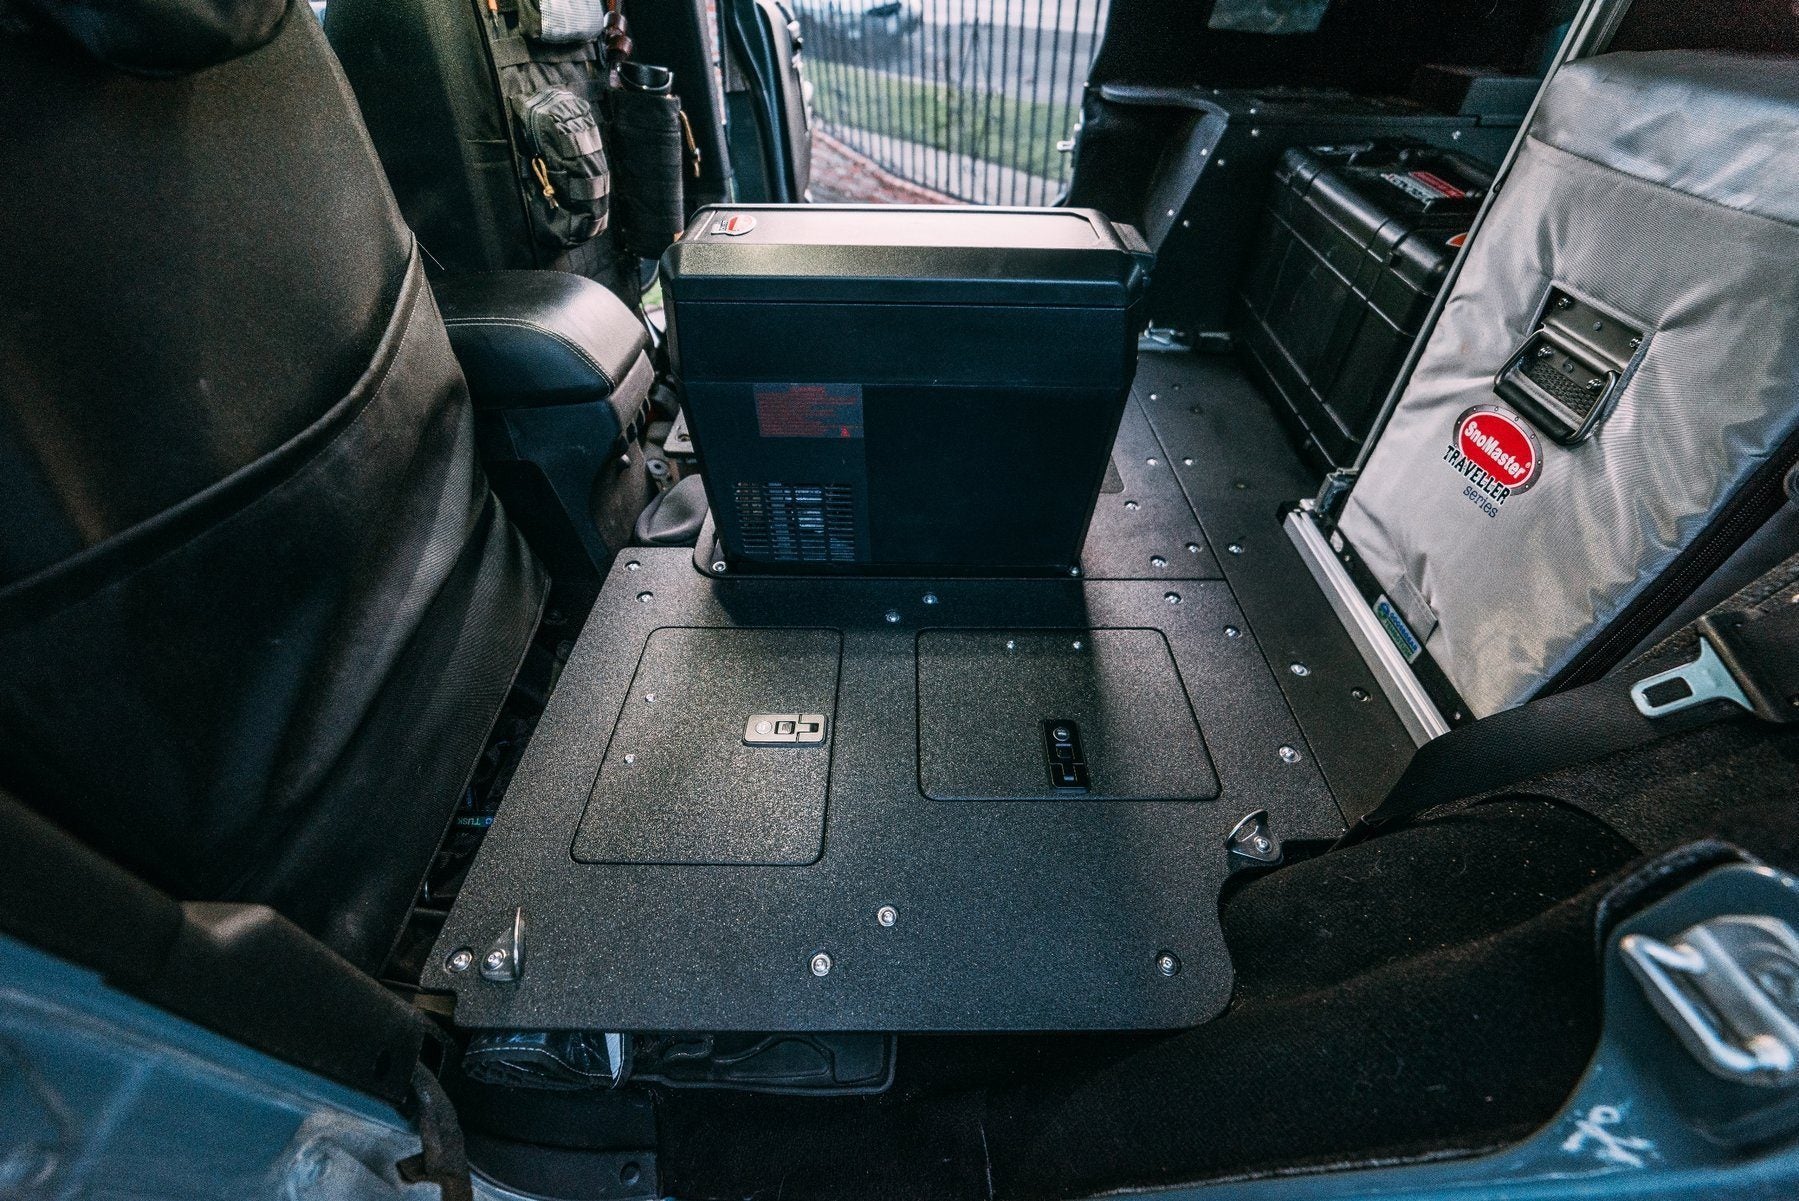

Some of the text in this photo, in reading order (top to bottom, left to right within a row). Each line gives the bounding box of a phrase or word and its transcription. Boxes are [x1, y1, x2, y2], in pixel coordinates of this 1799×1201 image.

[1443, 445, 1511, 505] TRAVELLER
[1464, 420, 1526, 479] SnoMaster
[1462, 485, 1498, 518] series
